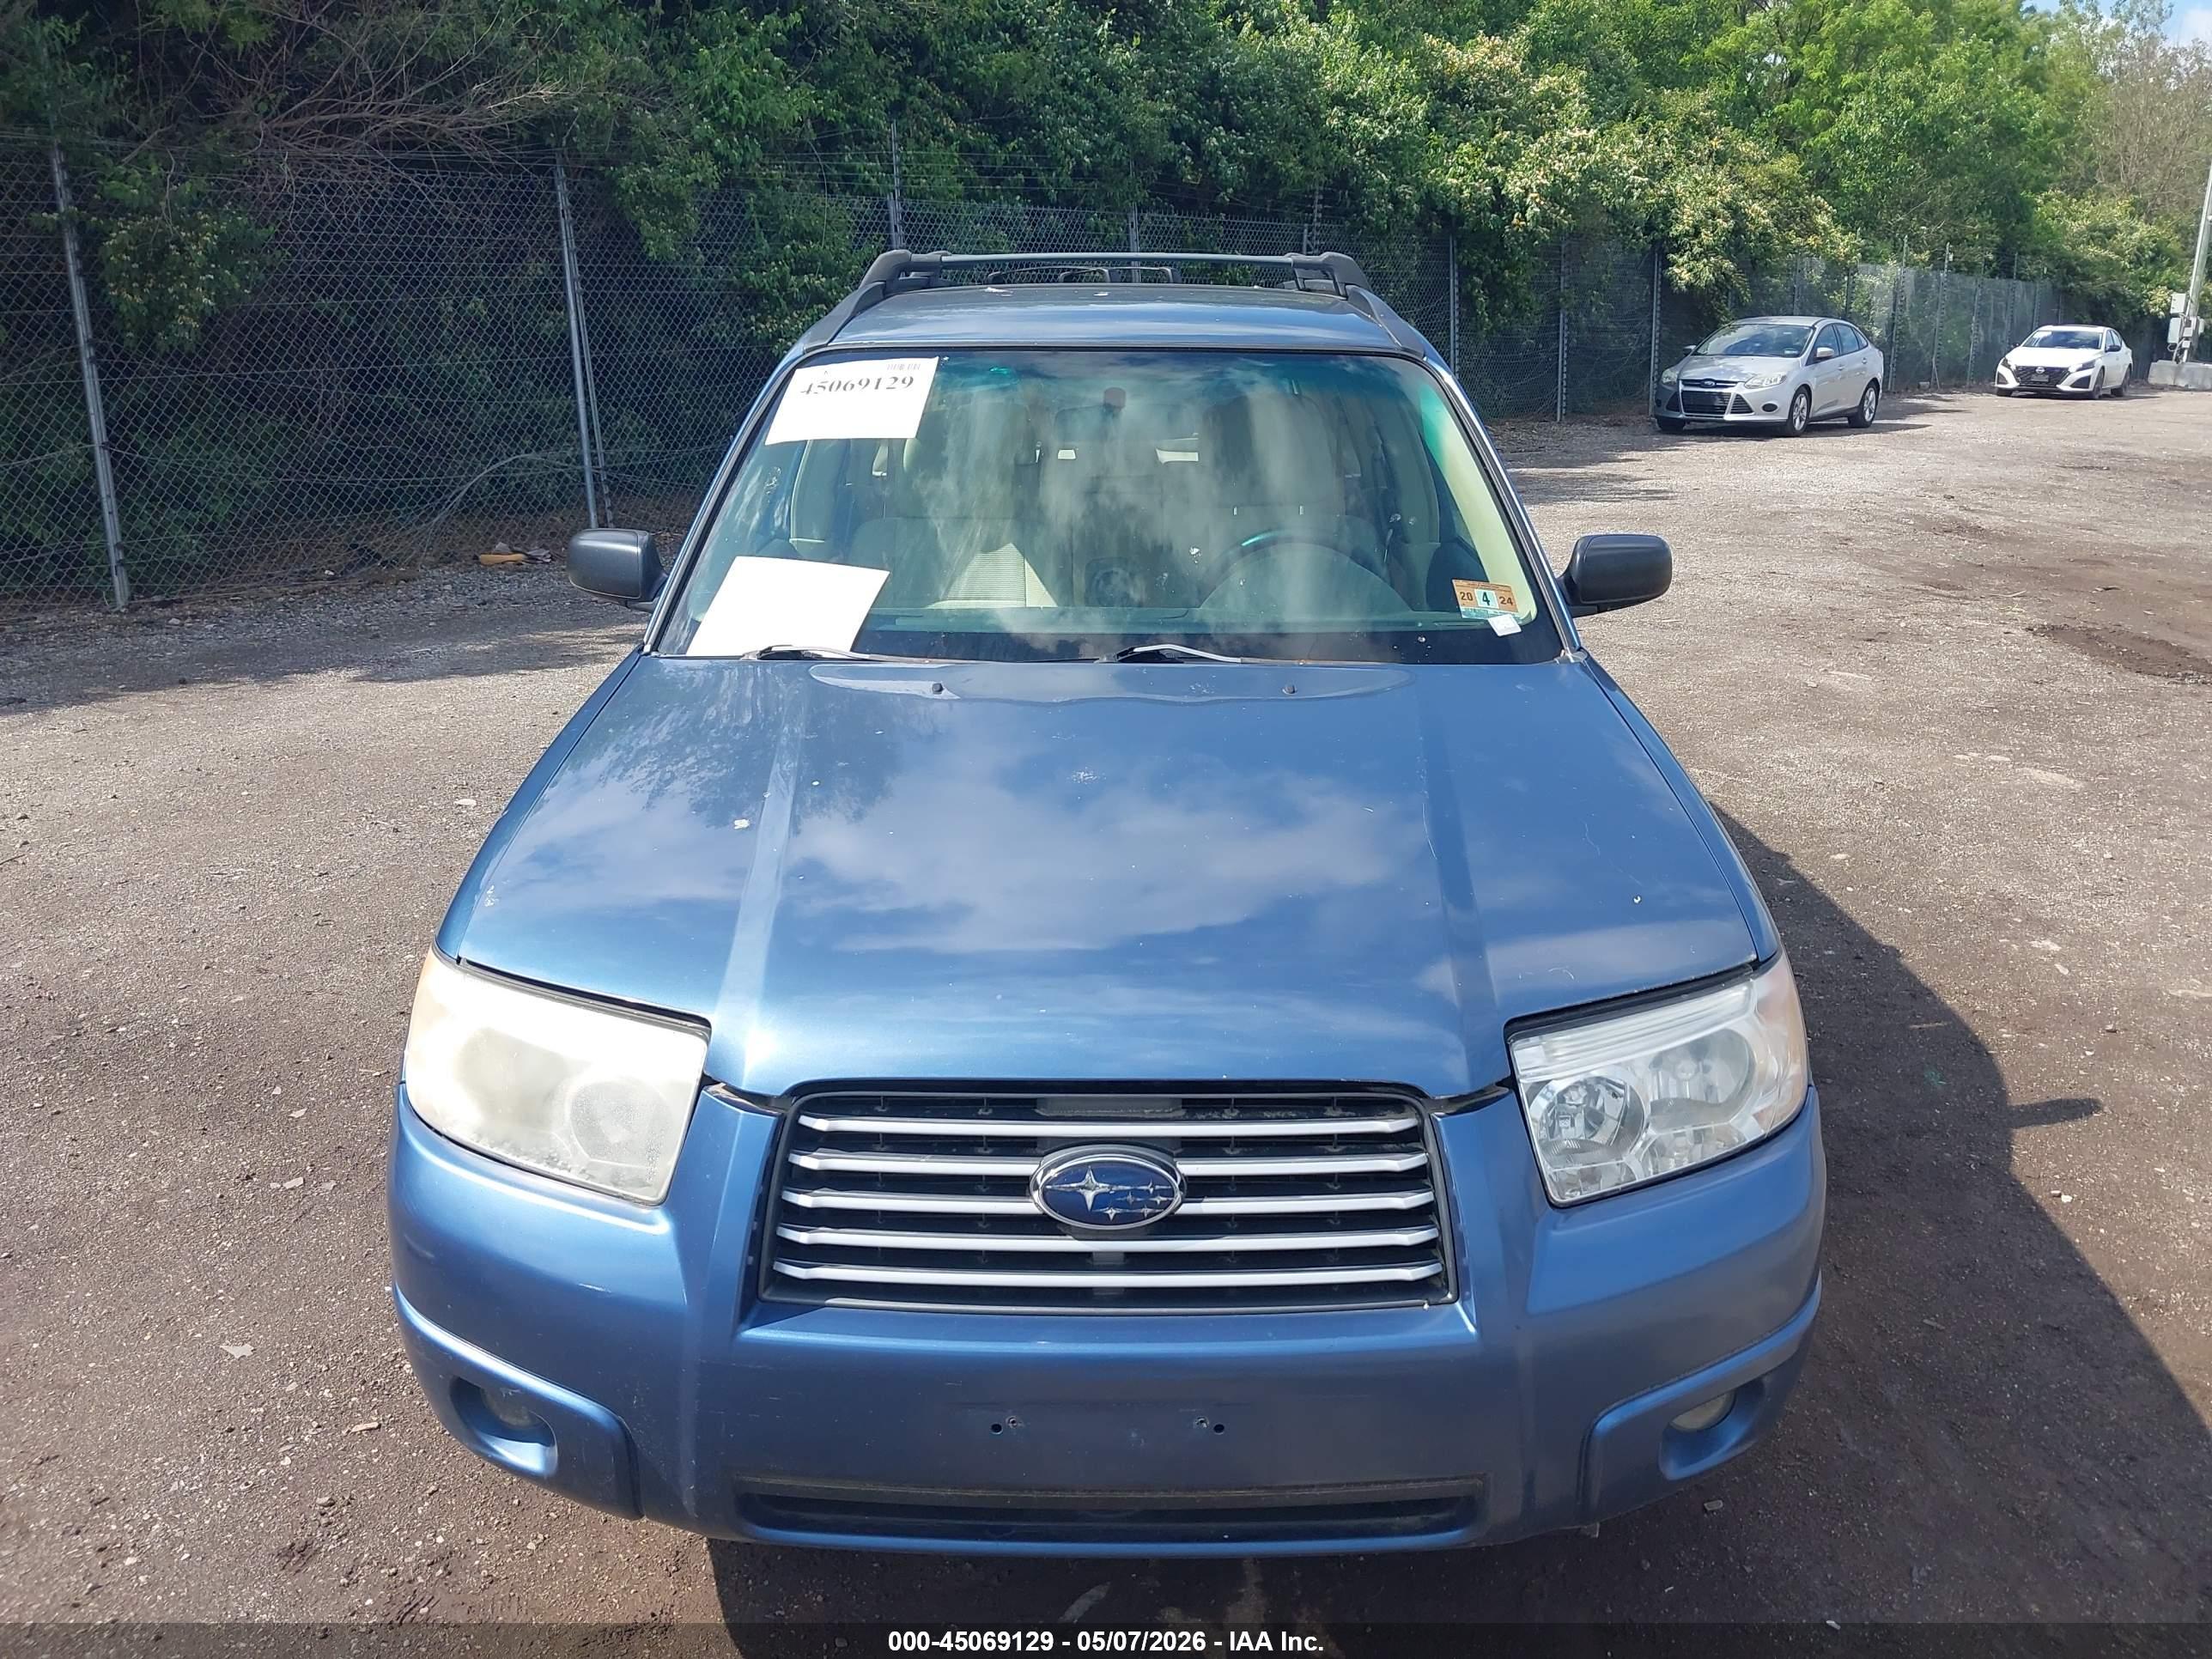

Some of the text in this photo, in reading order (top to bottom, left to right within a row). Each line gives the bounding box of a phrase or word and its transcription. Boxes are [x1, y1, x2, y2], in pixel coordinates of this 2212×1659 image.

[800, 376, 914, 395] 45069129
[1460, 592, 1513, 606] 20 4 24
